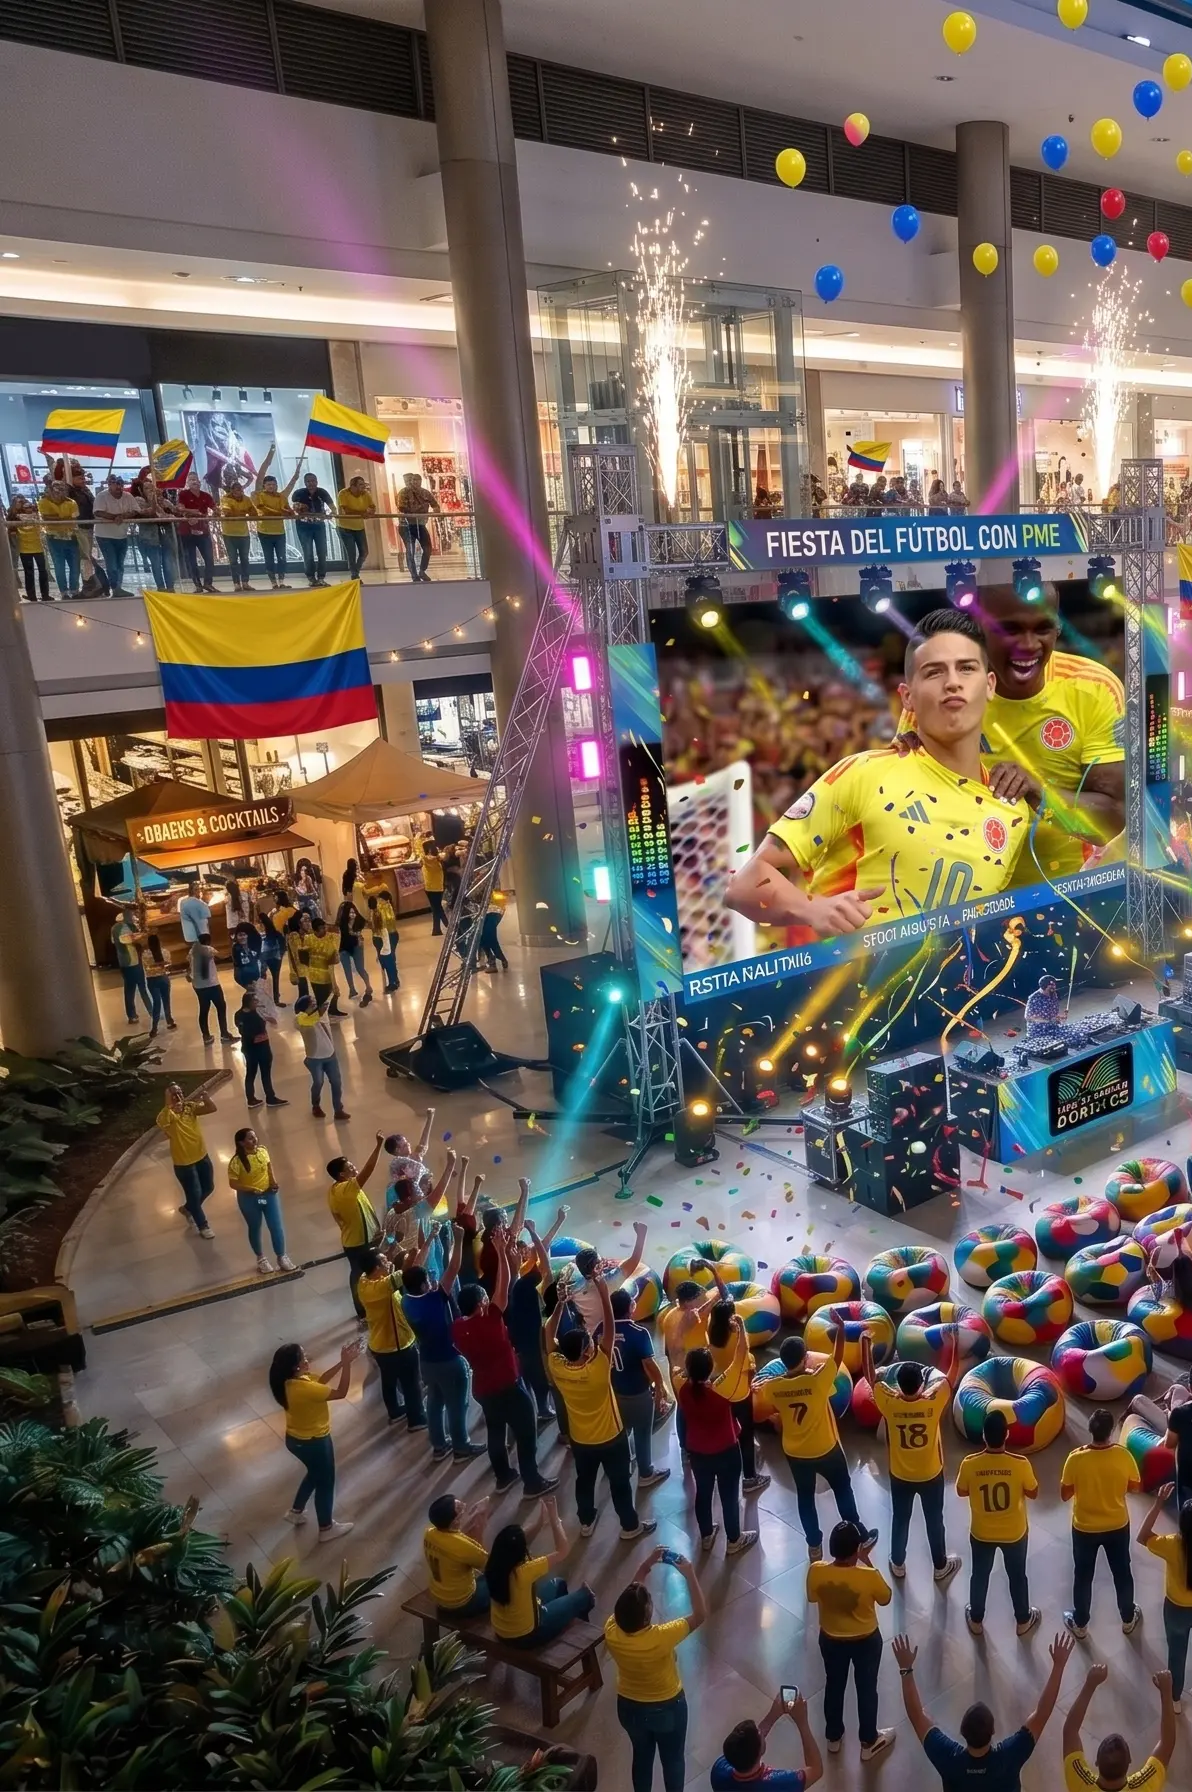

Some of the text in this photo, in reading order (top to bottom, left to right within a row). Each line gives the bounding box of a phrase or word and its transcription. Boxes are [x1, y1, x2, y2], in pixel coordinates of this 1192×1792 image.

[766, 522, 1061, 558] FIESTA DEL FÚTBOL CON PME
[197, 817, 208, 836] &
[209, 806, 280, 833] COCKTAILS
[788, 1402, 808, 1426] 7
[895, 1423, 929, 1450] 18
[979, 1481, 1011, 1513] 10
